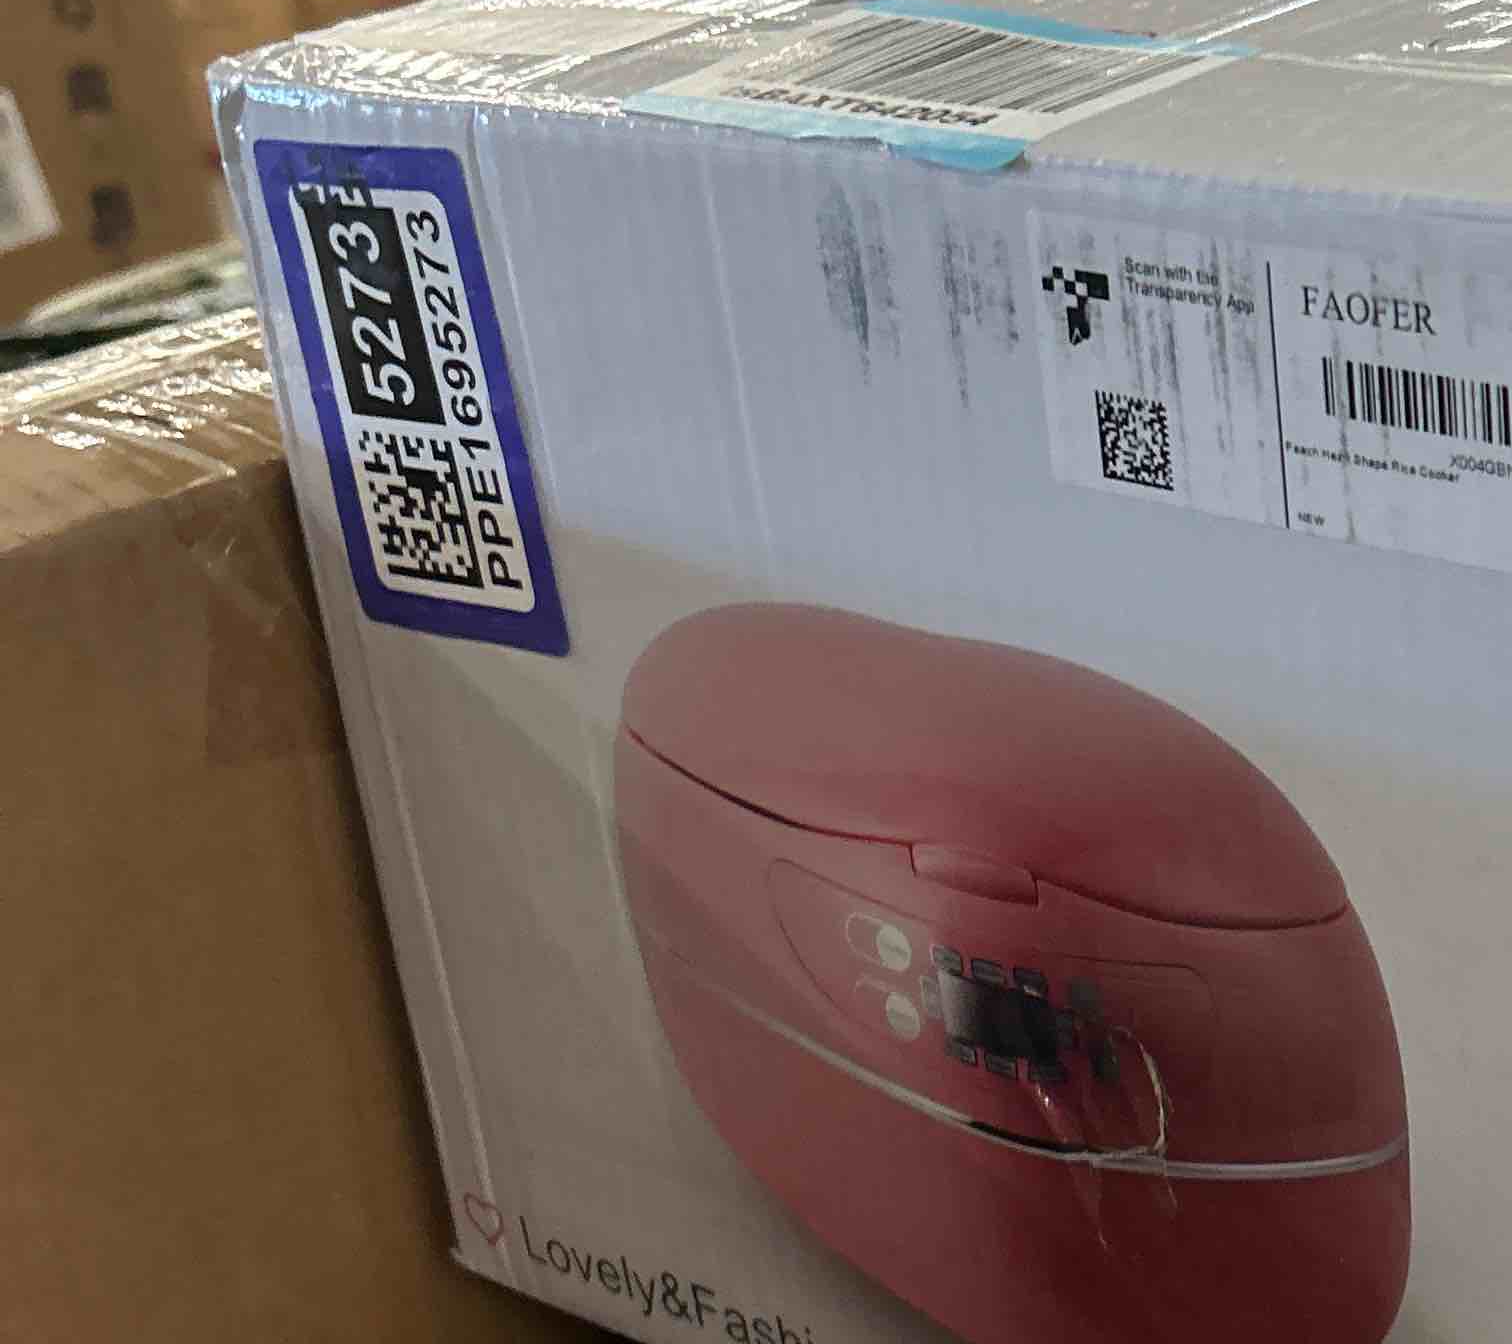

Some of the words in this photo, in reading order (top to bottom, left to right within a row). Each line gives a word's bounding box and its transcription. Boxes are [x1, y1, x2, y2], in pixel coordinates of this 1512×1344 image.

[1124, 256, 1161, 279] Scan
[328, 217, 418, 407] 5273
[1126, 276, 1222, 308] Transparency
[1226, 292, 1256, 315] App
[1301, 285, 1439, 339] FAOFER
[406, 209, 524, 592] PPE1695273
